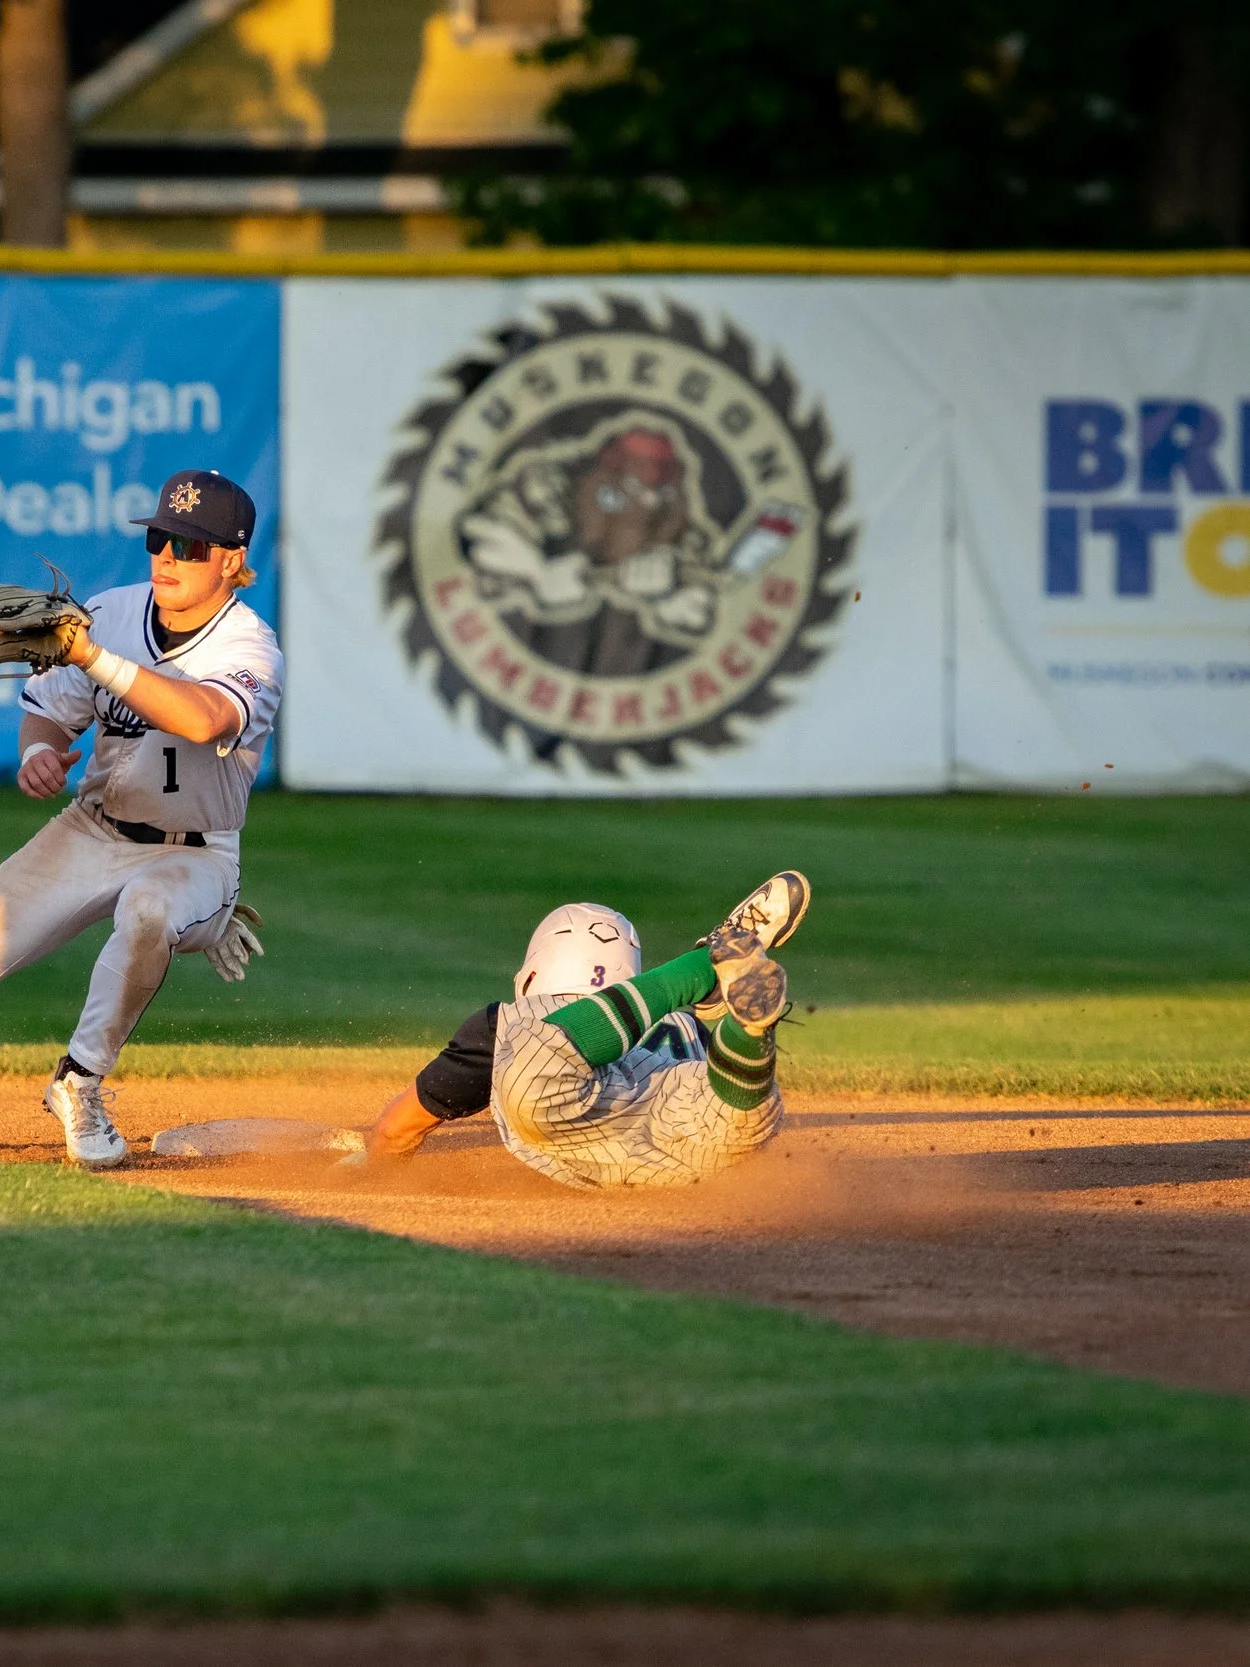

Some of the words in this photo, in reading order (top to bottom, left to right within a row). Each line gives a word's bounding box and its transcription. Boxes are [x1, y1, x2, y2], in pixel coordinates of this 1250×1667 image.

[442, 347, 789, 489] MUSKEGON
[433, 570, 798, 727] LUMBERJACKS
[162, 746, 180, 794] 1
[590, 965, 606, 987] 3
